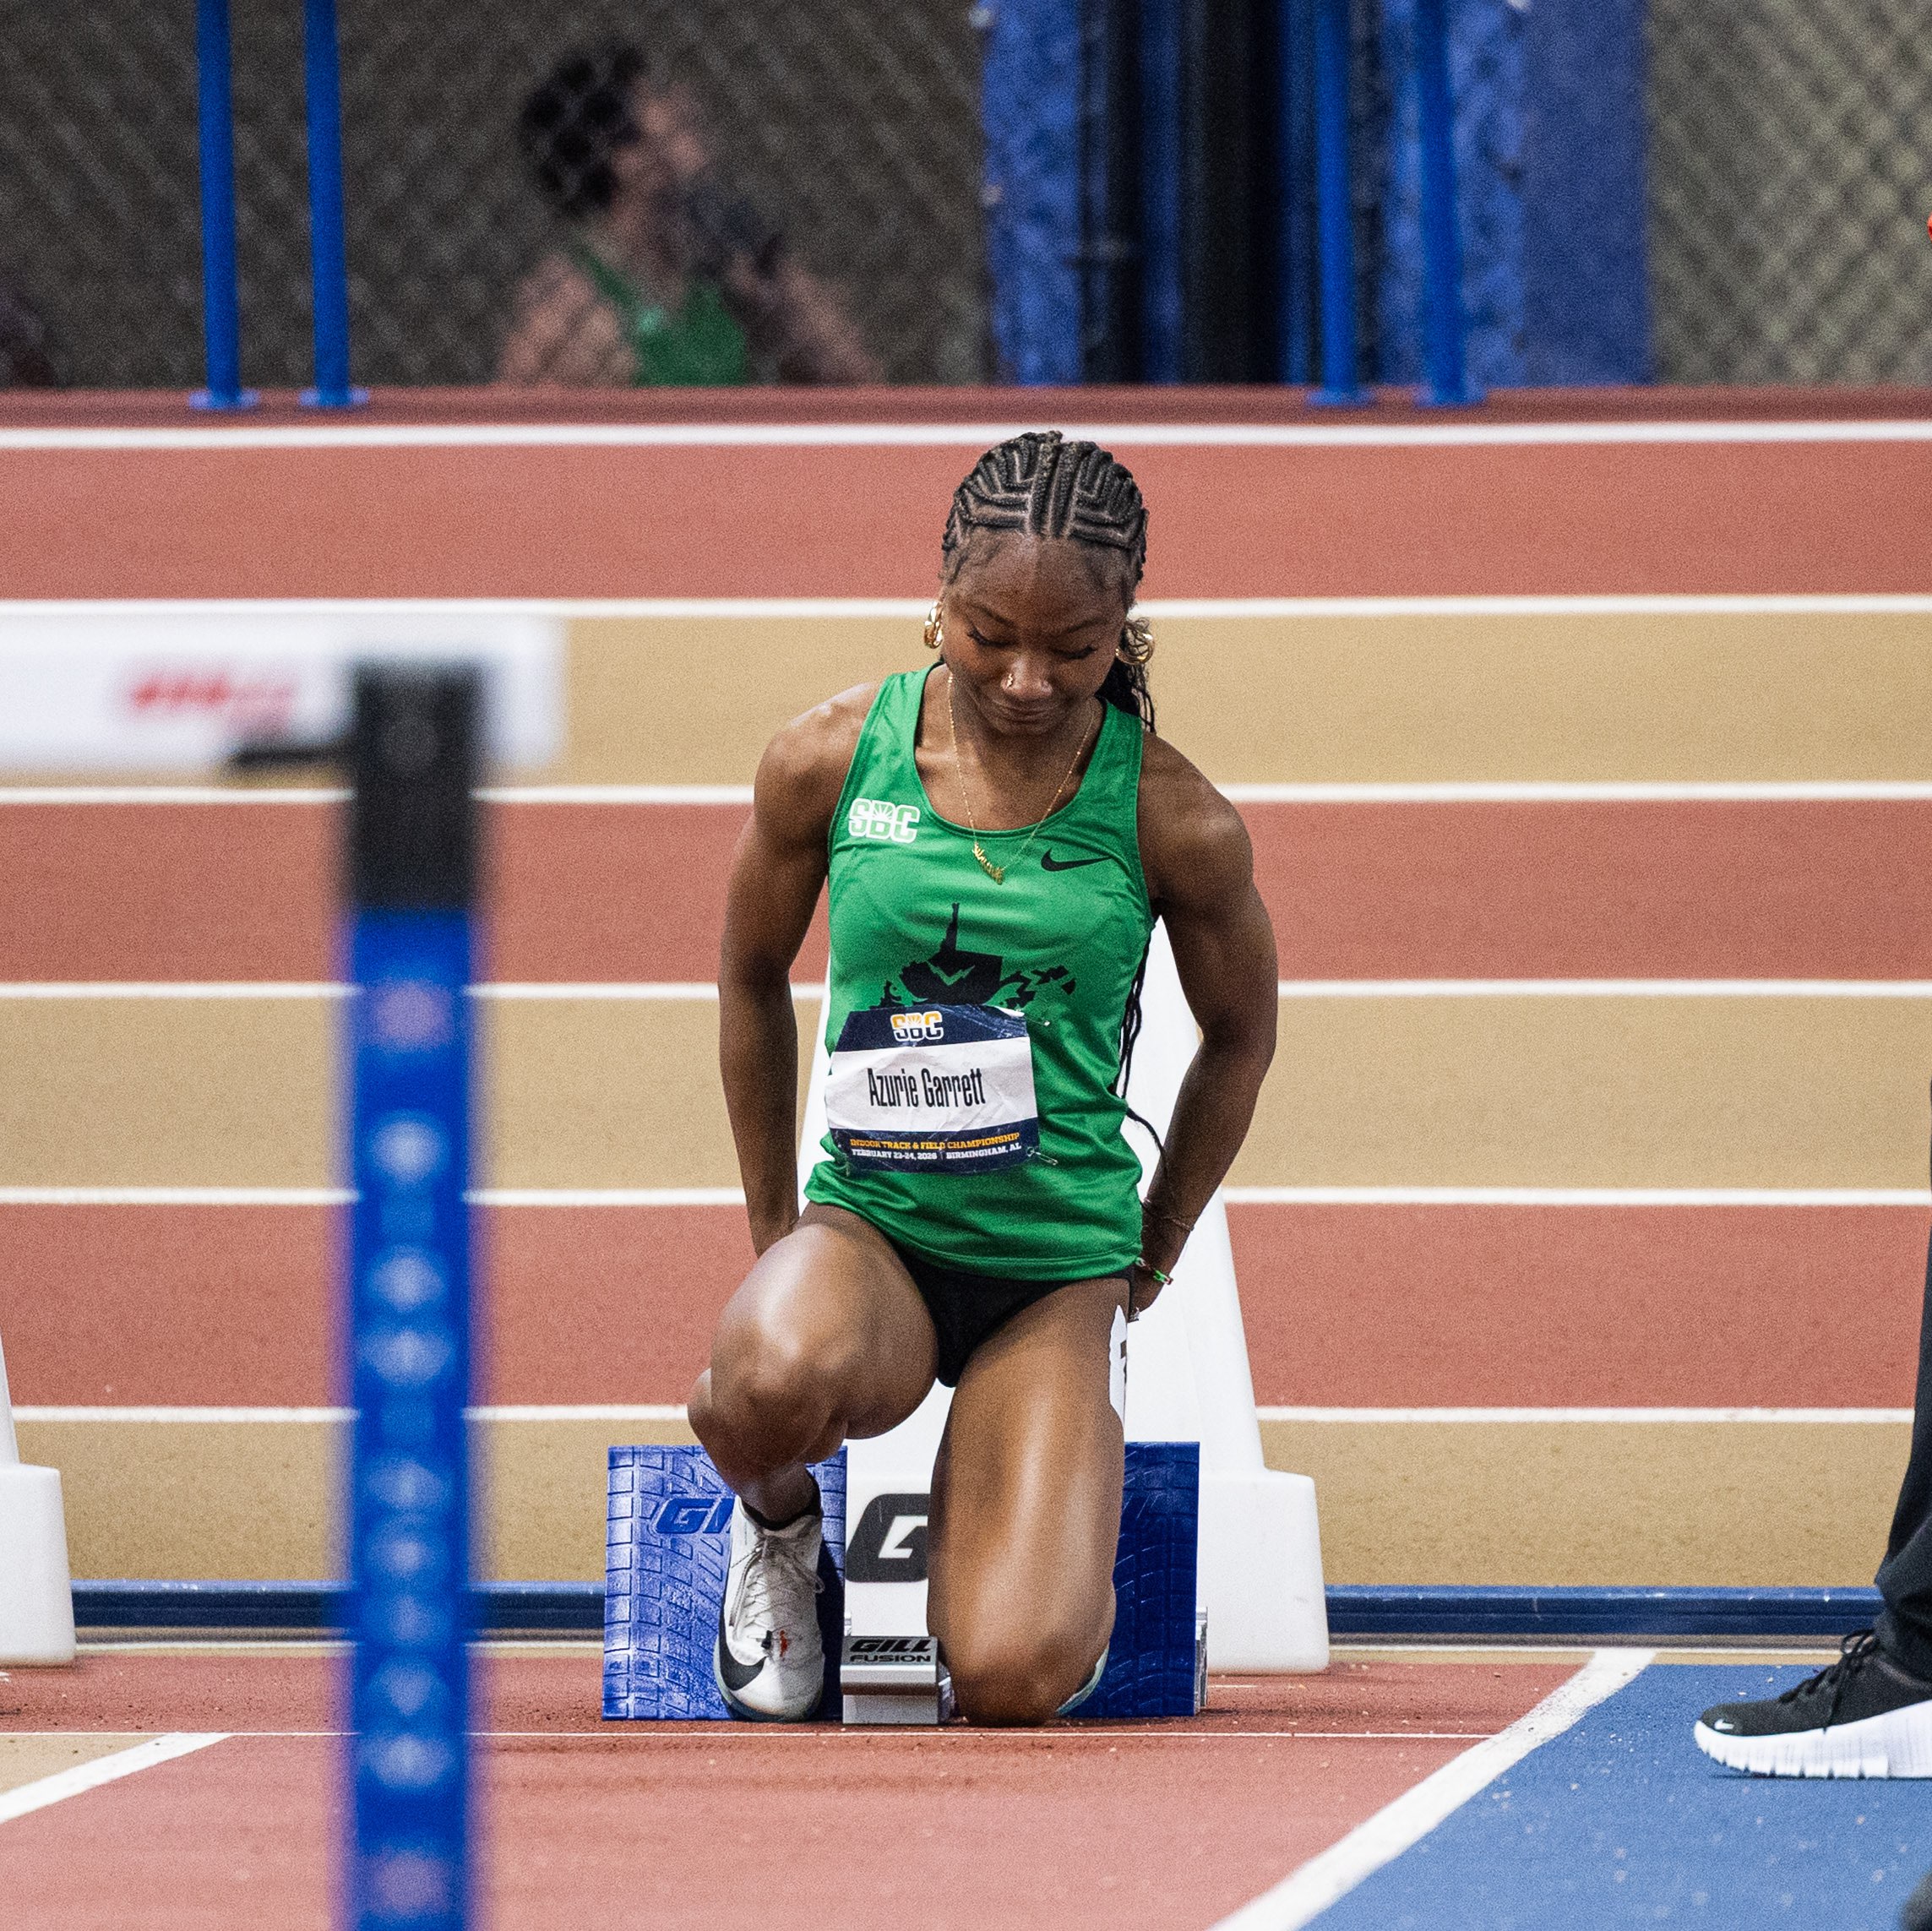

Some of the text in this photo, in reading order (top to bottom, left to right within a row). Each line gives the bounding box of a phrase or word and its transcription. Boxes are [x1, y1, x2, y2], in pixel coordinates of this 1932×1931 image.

[848, 797, 921, 844] SBC
[890, 1010, 944, 1042] SBC
[867, 1067, 986, 1107] Azurie Garrett
[850, 1132, 1020, 1150] INDOOR TRACK & FIELD CHAMPIONSHIP
[852, 1148, 892, 1159] FEBRUARY
[1010, 1142, 1022, 1150] AL
[656, 1498, 735, 1534] GI
[850, 1639, 930, 1652] GILL
[850, 1654, 931, 1662] FUSION
